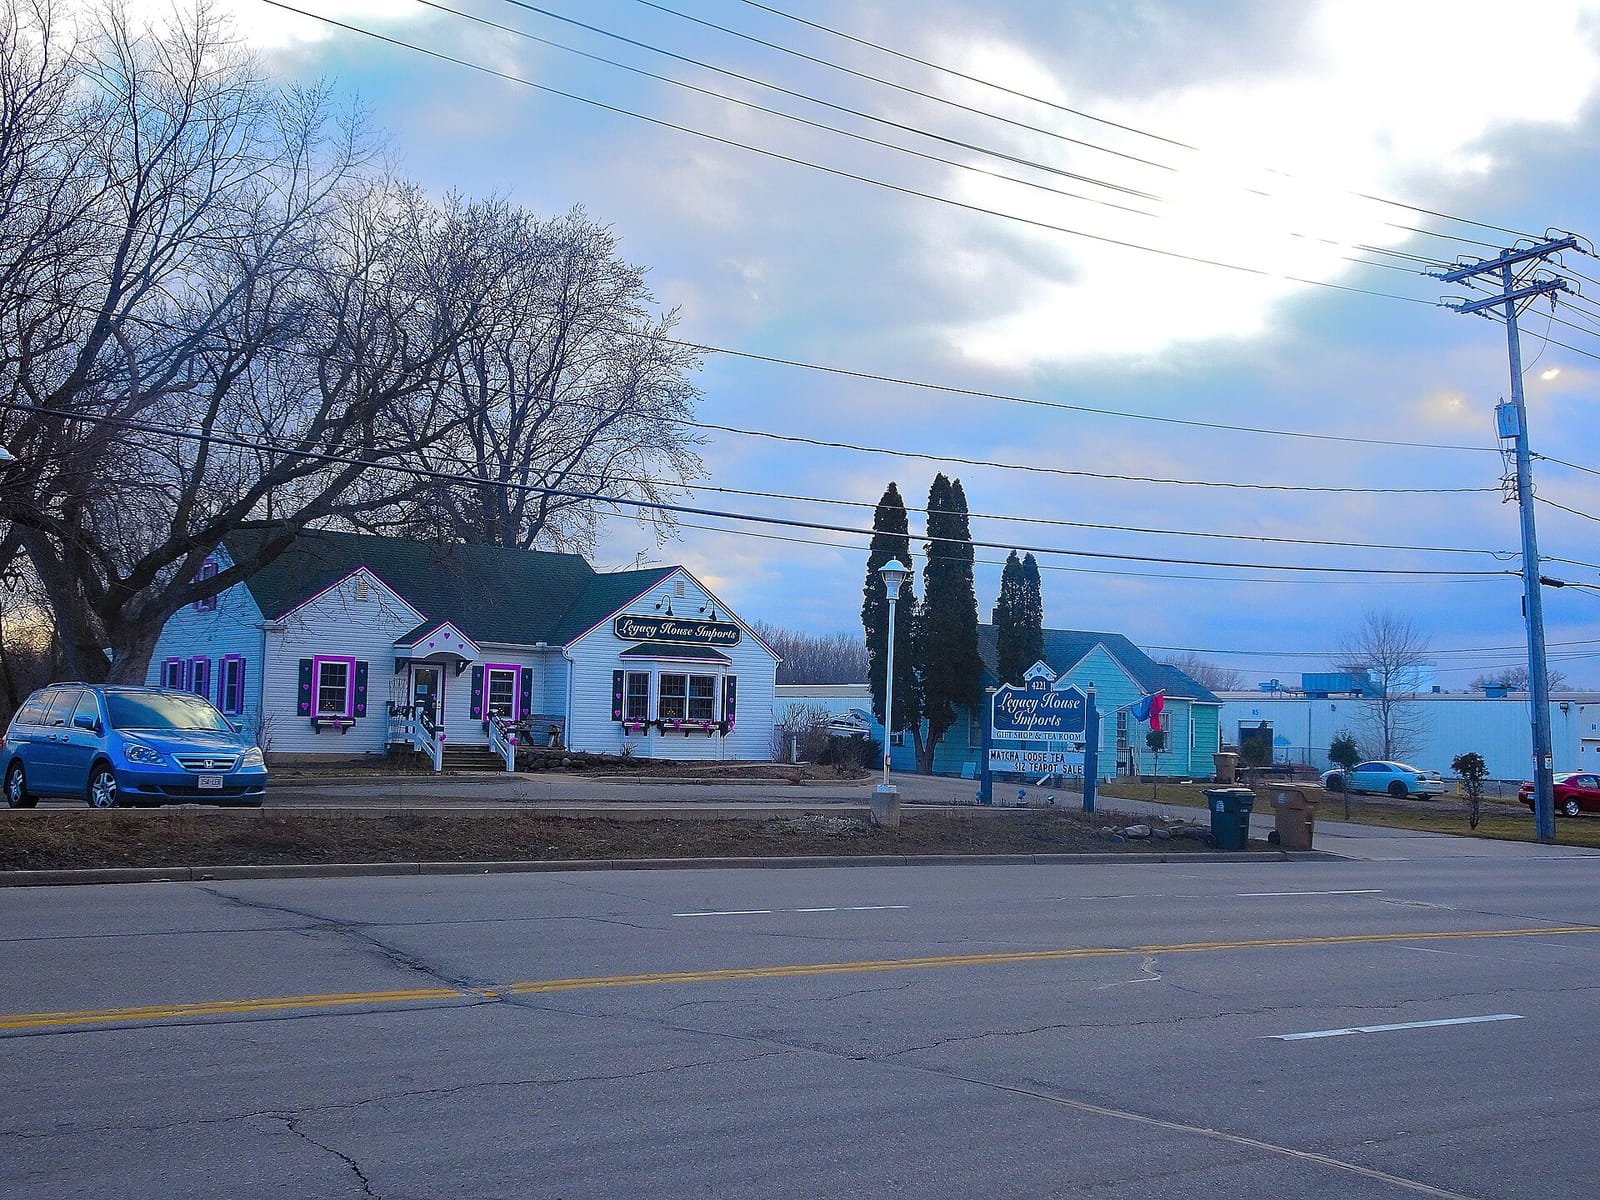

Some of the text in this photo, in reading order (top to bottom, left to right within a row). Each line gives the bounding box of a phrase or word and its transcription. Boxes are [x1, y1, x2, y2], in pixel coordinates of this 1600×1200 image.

[620, 619, 736, 641] Legacy House Imports
[1032, 681, 1046, 690] 4221
[998, 692, 1080, 713] Legacy House
[1012, 710, 1061, 731] Imports
[997, 731, 1080, 741] GIFT SHOP & TEA ROOM
[990, 751, 1065, 763] MATCHA LOOSE TEA
[1015, 763, 1082, 774] $12 TEAPOT SALE
